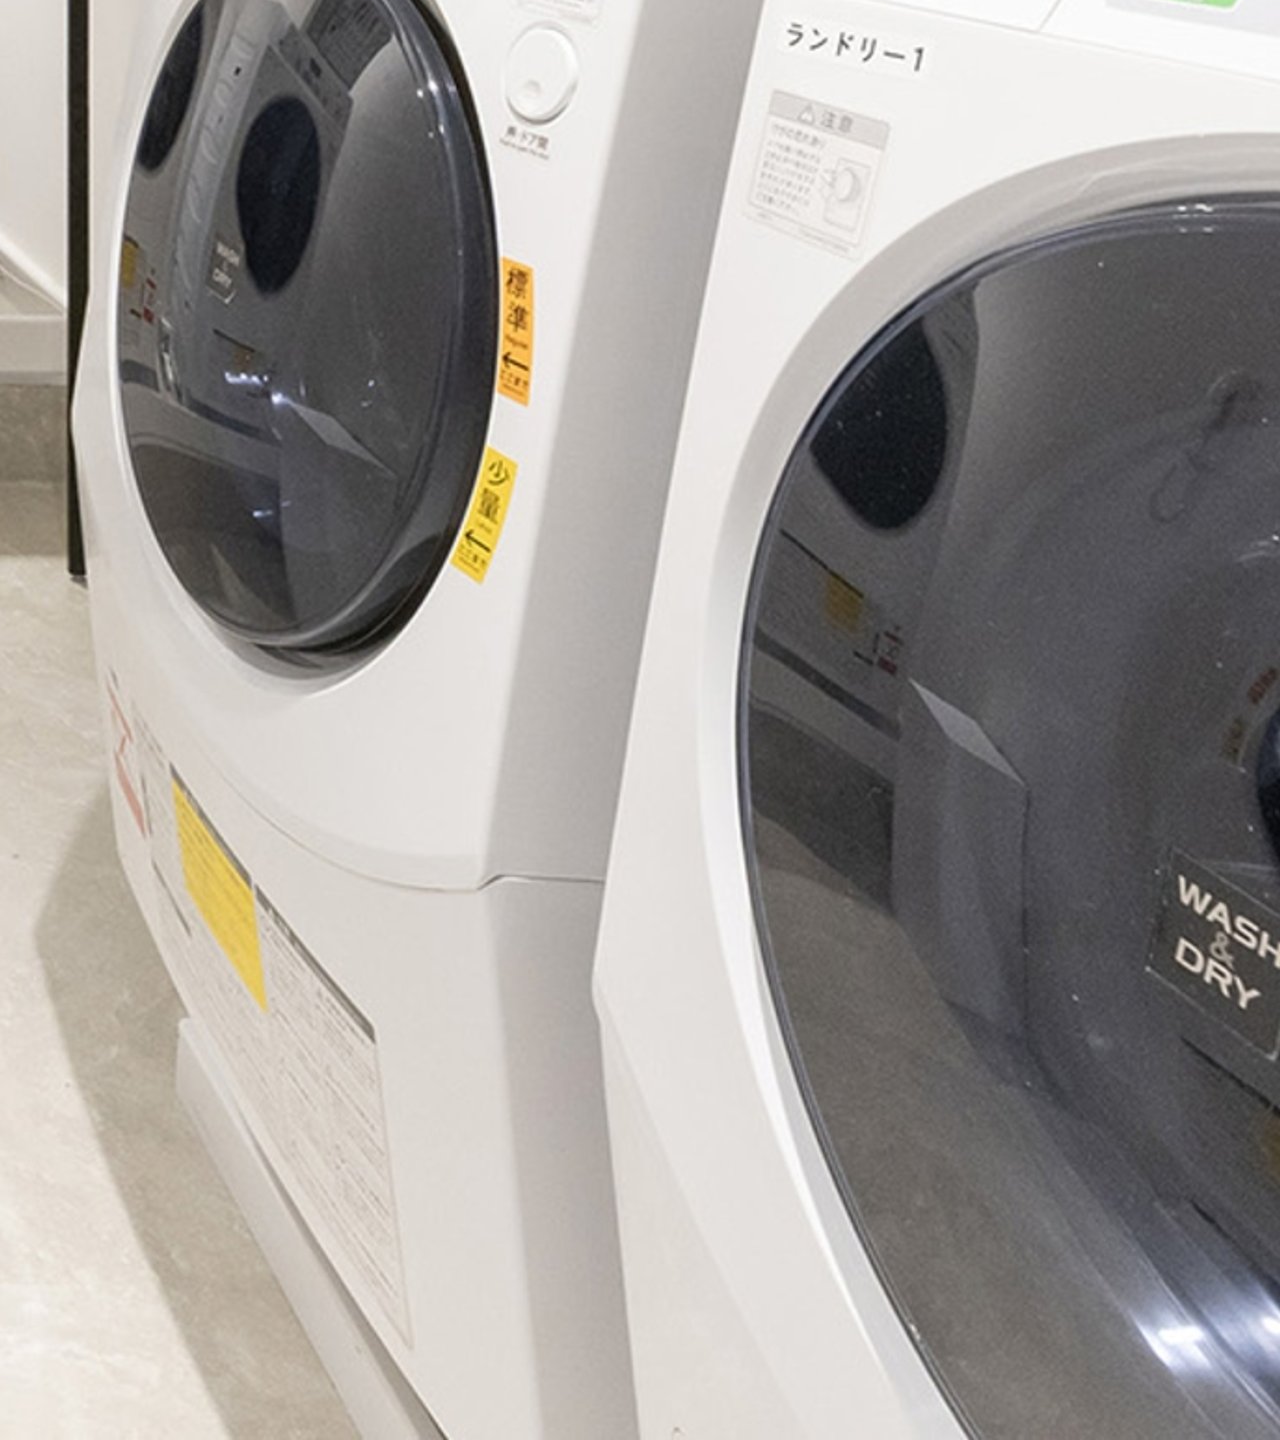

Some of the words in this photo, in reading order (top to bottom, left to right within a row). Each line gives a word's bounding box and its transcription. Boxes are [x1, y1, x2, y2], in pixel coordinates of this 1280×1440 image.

[786, 21, 926, 73] ランドリー1
[1178, 874, 1280, 969] WASH
[1175, 936, 1262, 1010] DRY
